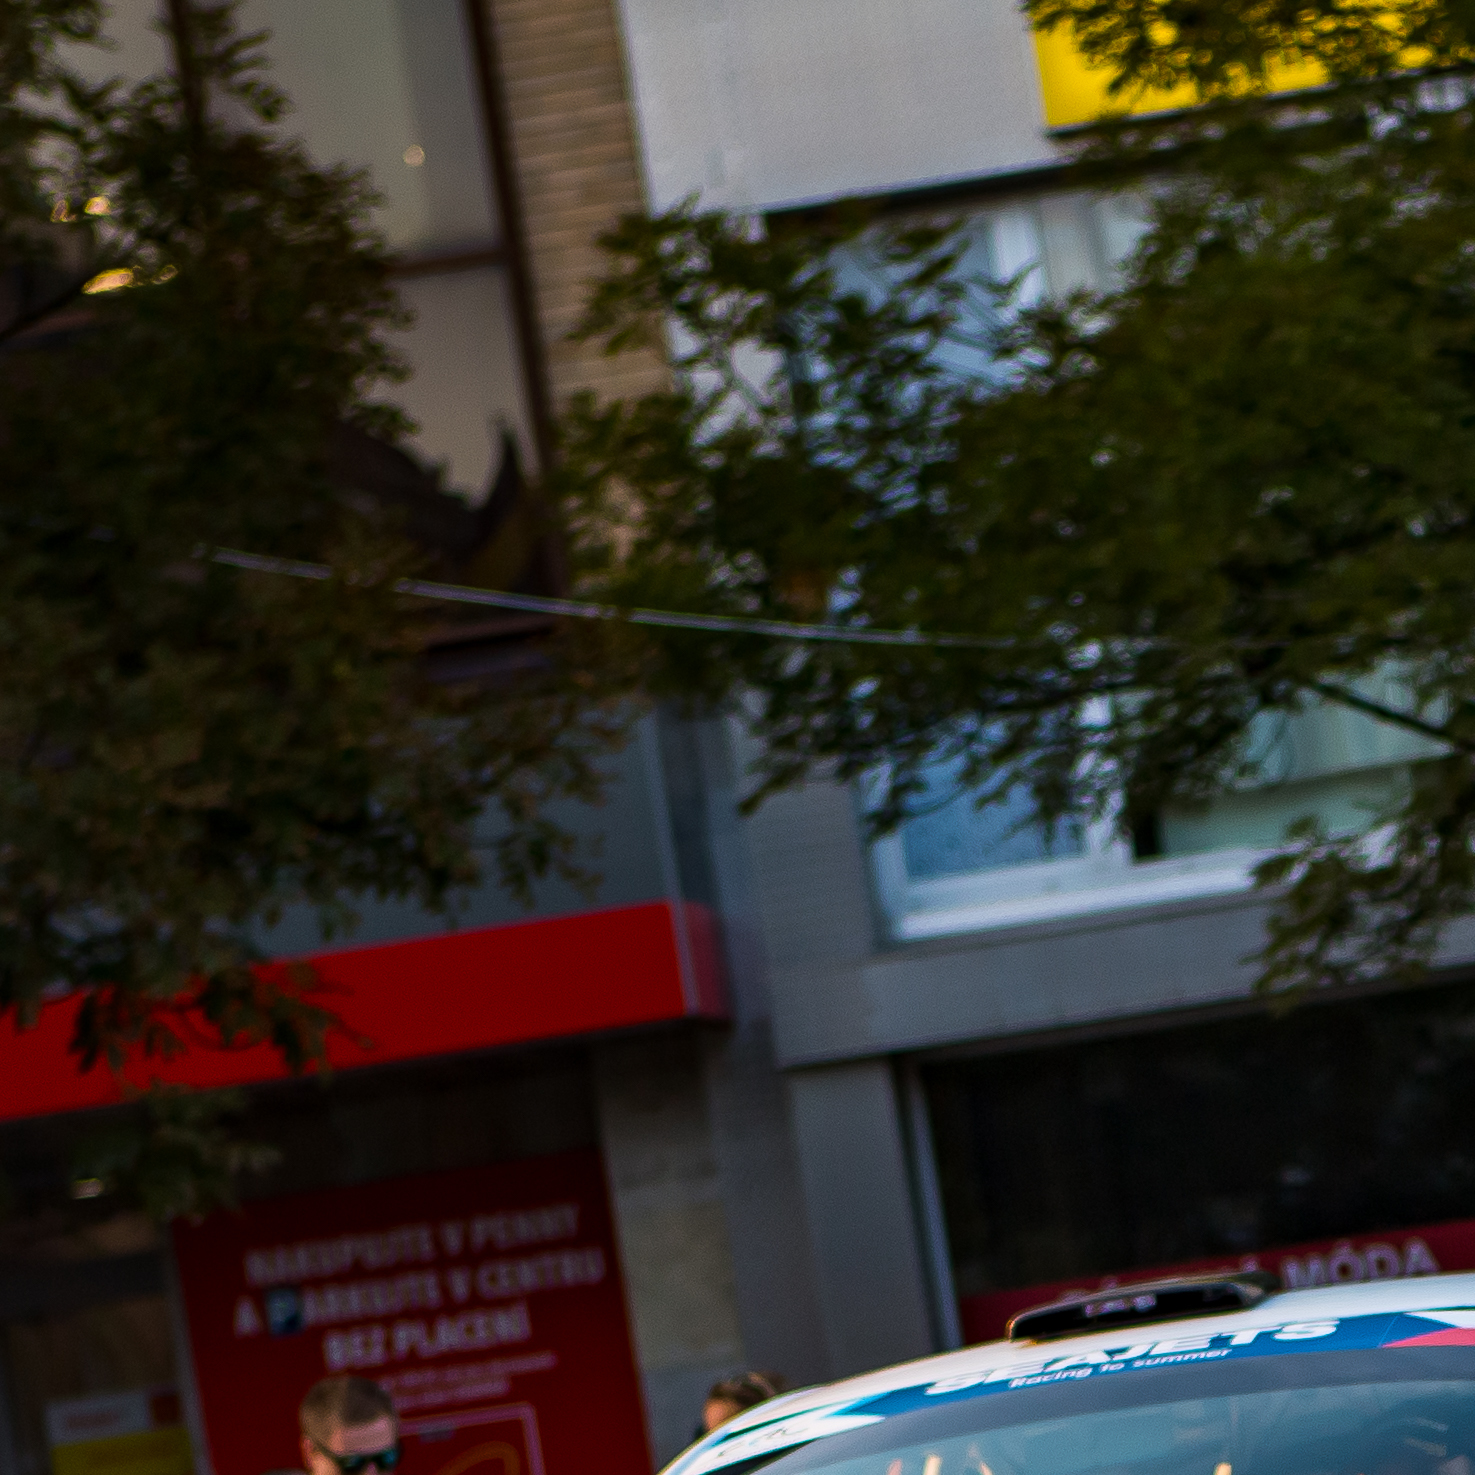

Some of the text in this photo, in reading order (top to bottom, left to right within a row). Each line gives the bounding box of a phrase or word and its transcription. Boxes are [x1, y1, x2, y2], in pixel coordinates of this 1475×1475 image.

[924, 1318, 1341, 1397] SEAJETS
[1008, 1362, 1093, 1390] Racing
[1132, 1345, 1234, 1370] summer
